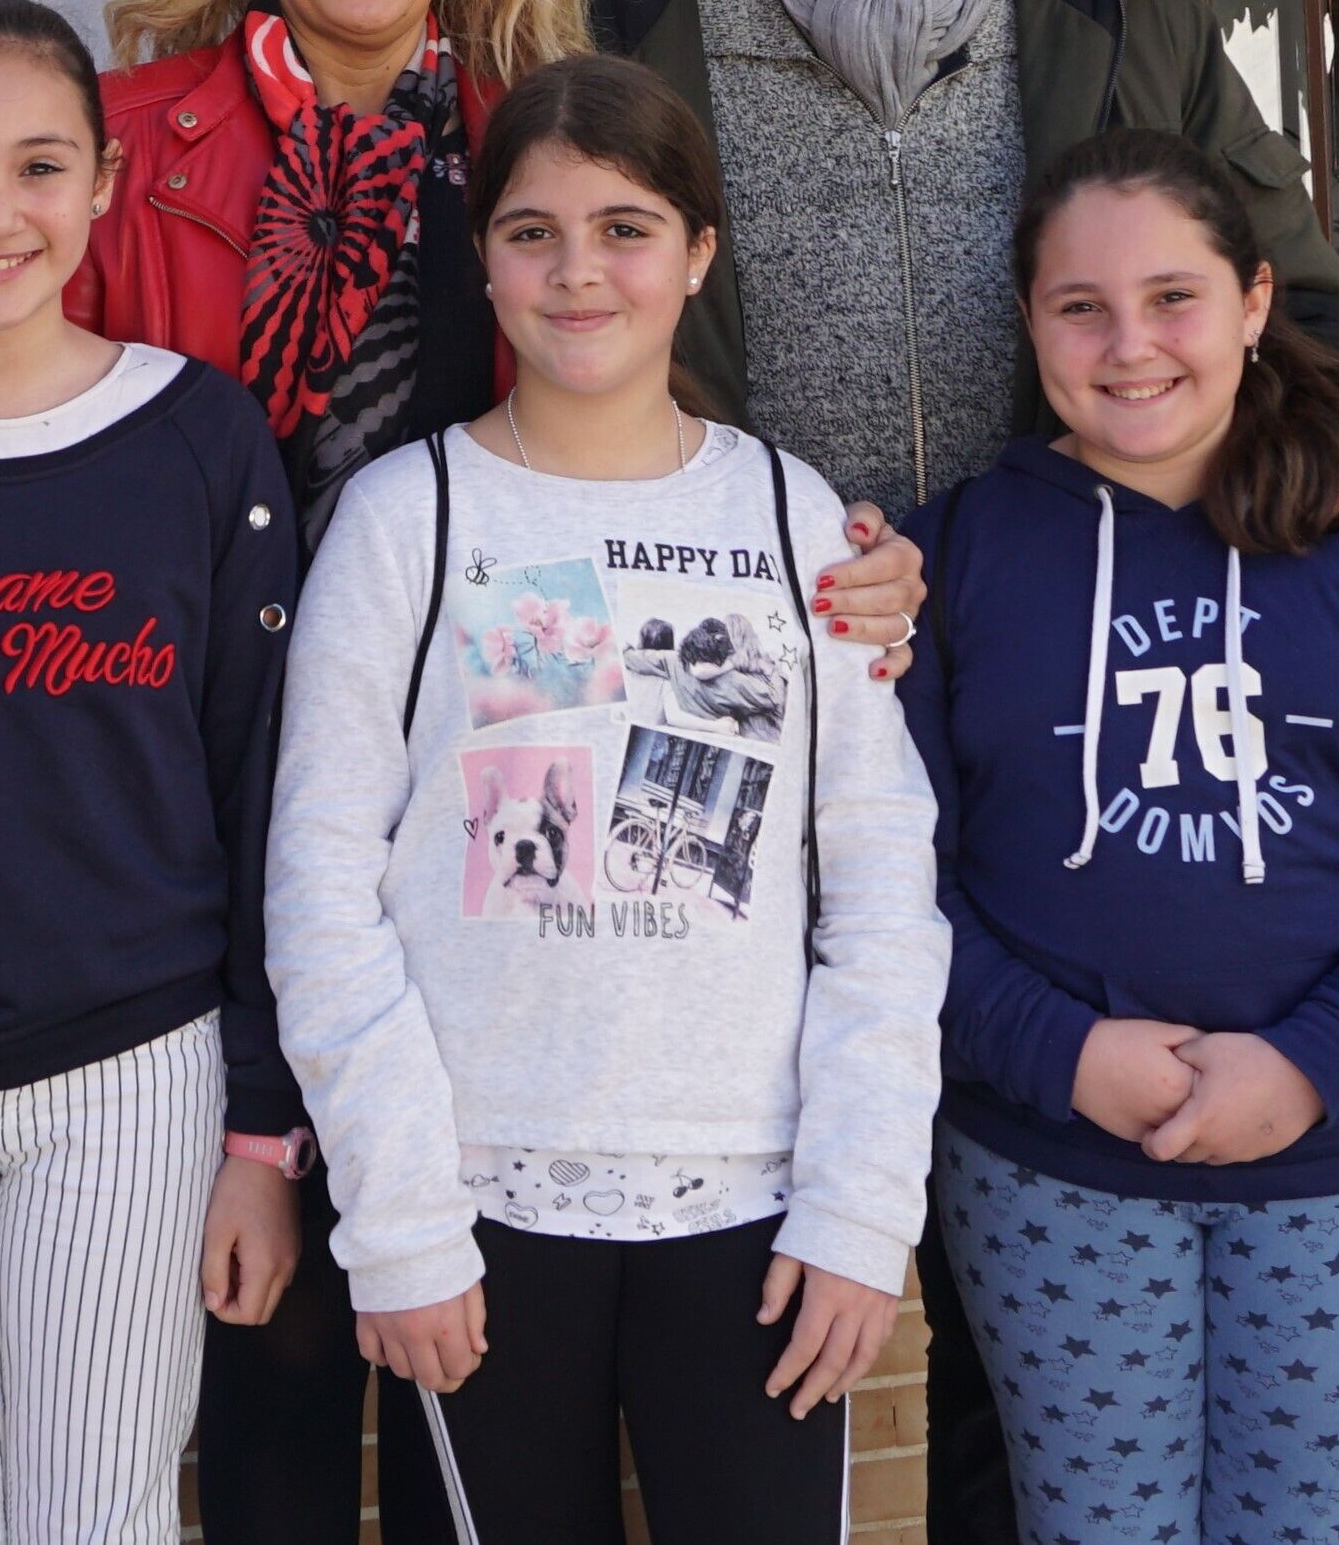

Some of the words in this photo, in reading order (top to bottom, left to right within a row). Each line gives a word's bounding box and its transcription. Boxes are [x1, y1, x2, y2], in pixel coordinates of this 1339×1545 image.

[604, 539, 718, 576] HAPPY
[730, 549, 782, 585] DA
[1, 617, 176, 696] Mucho
[1115, 662, 1269, 789] 76
[539, 902, 596, 939] FUN
[611, 901, 690, 939] VIBES
